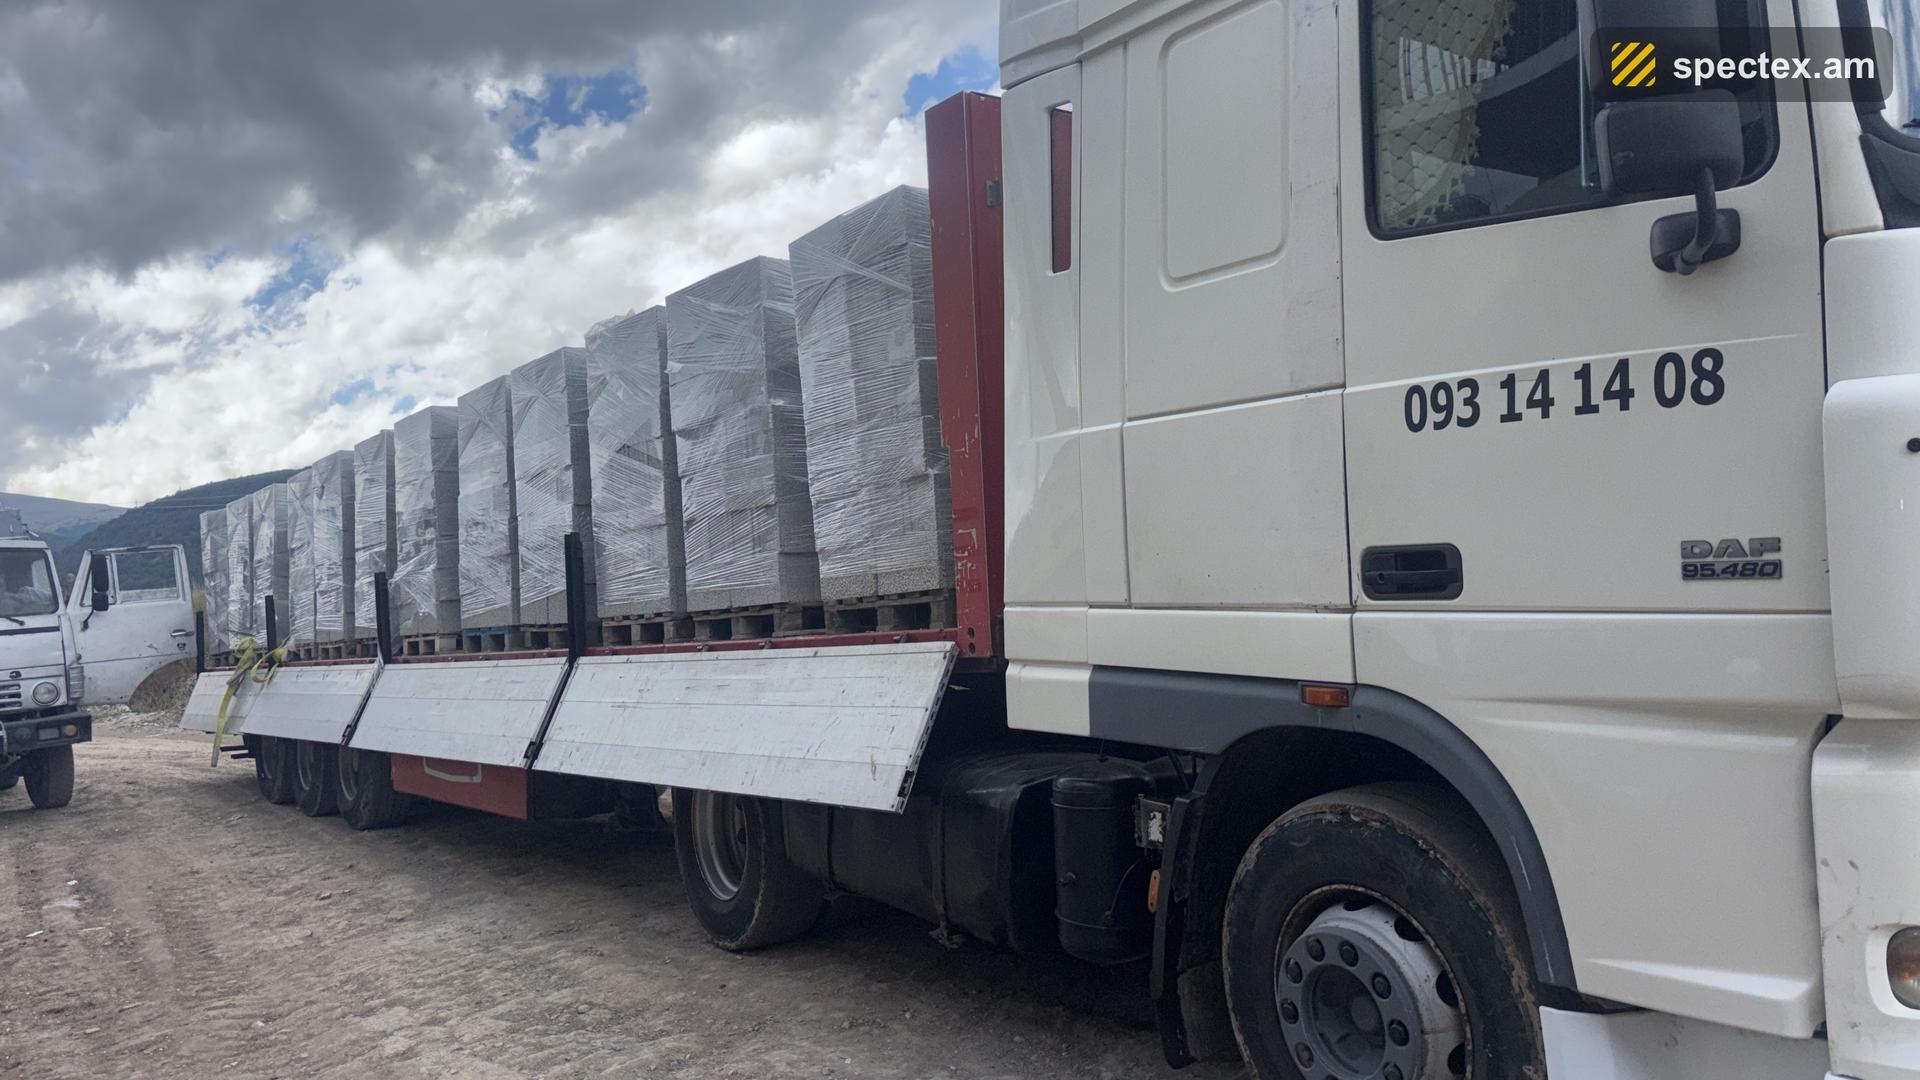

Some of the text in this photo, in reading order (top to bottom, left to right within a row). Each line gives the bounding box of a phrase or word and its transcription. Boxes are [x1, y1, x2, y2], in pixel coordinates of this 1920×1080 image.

[1404, 347, 1725, 433] 093 14 14 08
[1681, 537, 1781, 559] DAF
[1682, 561, 1780, 578] 95.480
